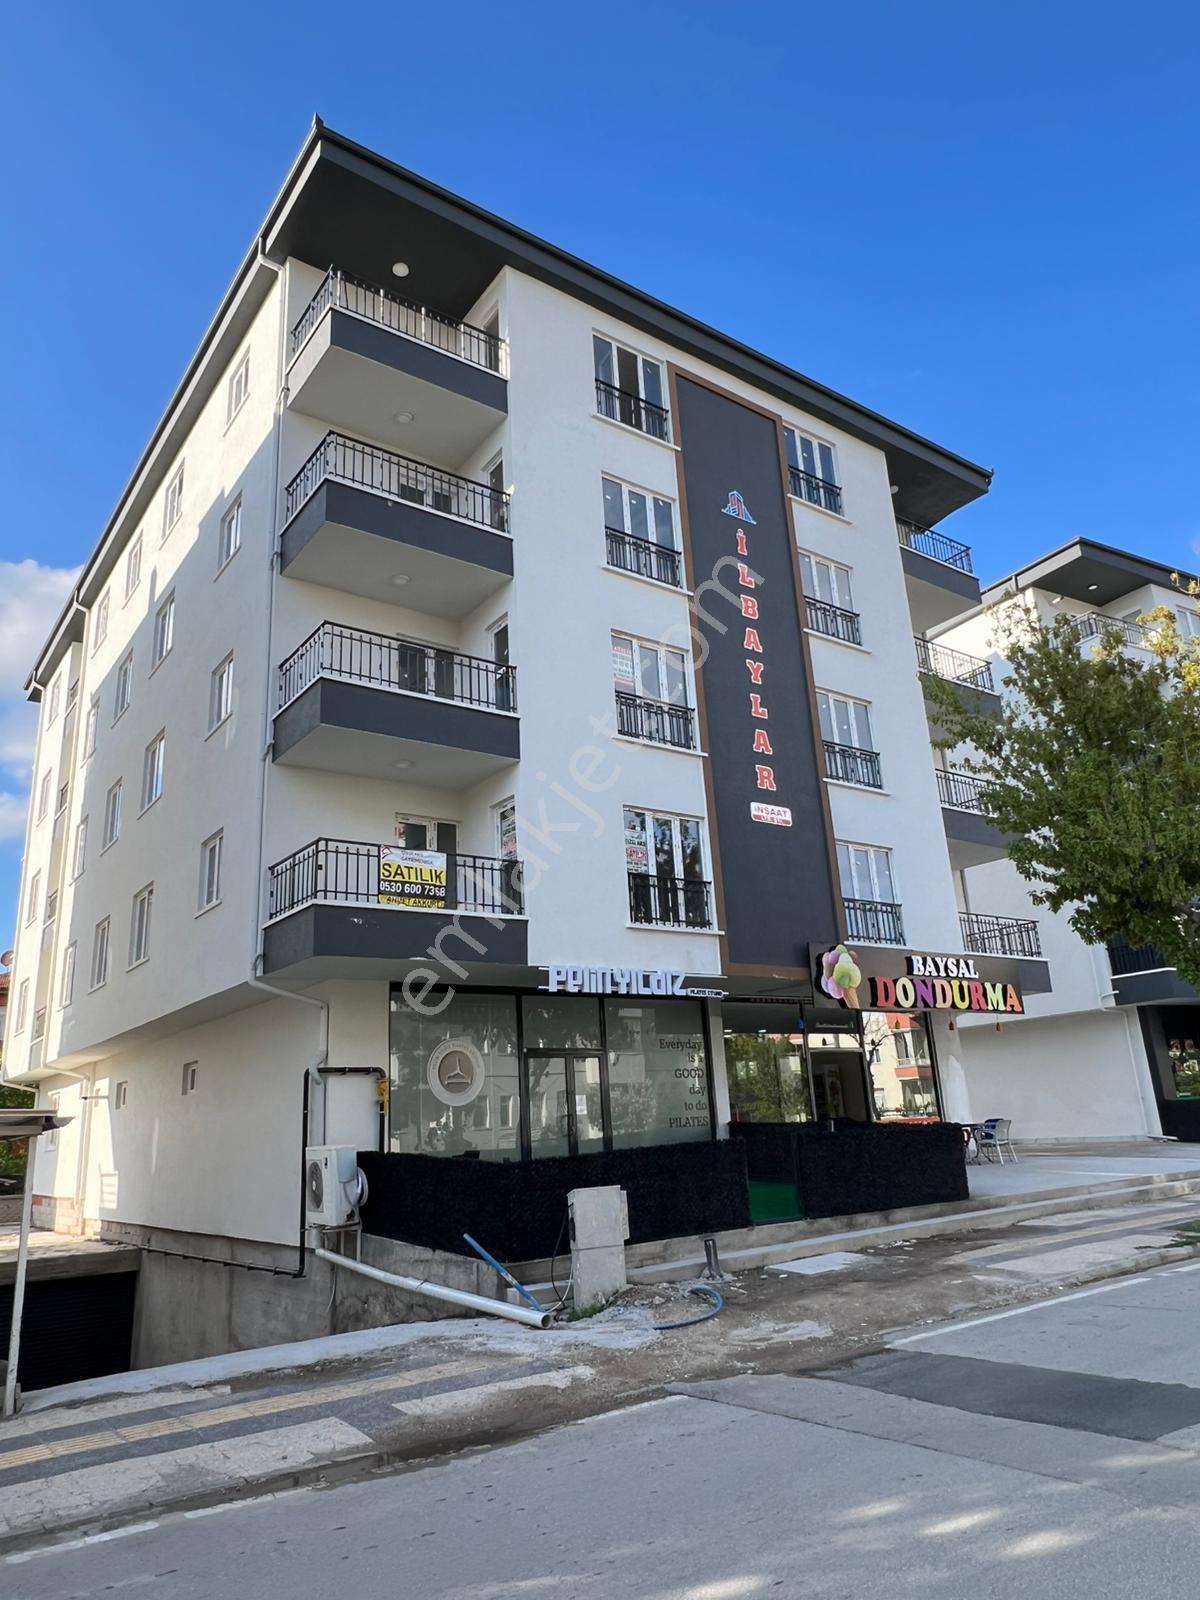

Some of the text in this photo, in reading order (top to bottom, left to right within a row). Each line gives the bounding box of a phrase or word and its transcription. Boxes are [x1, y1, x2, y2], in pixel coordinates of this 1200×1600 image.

[736, 528, 777, 791] İLBAYLAR
[382, 863, 444, 884] SATILIK
[380, 881, 402, 893] 0530
[404, 883, 422, 895] 600
[910, 955, 979, 979] BAYSAL
[873, 975, 1023, 1012] DONDURMA
[659, 1039, 703, 1051] Everyday
[688, 1053, 695, 1062] is
[674, 1068, 704, 1079] GOOD
[689, 1084, 706, 1096] day
[684, 1100, 707, 1111] to do
[669, 1116, 709, 1128] PILATES
